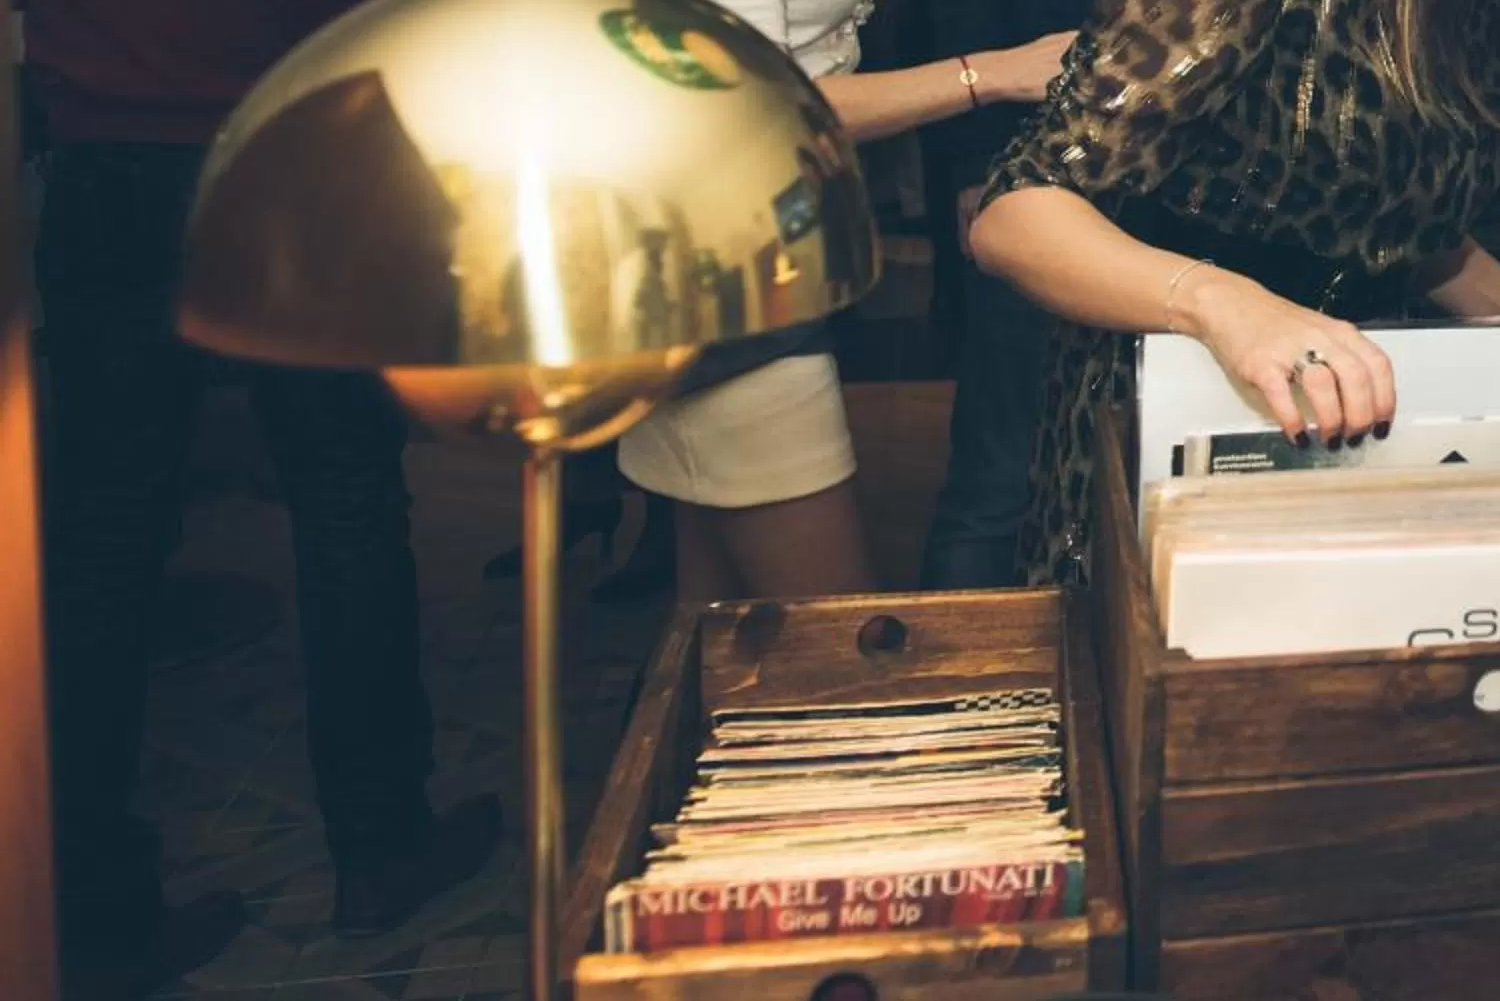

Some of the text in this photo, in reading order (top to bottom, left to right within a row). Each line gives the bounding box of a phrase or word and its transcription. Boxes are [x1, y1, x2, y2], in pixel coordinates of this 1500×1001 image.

[637, 863, 1056, 916] MICHAEL FORTUNATI
[777, 901, 923, 931] Give Me Up
